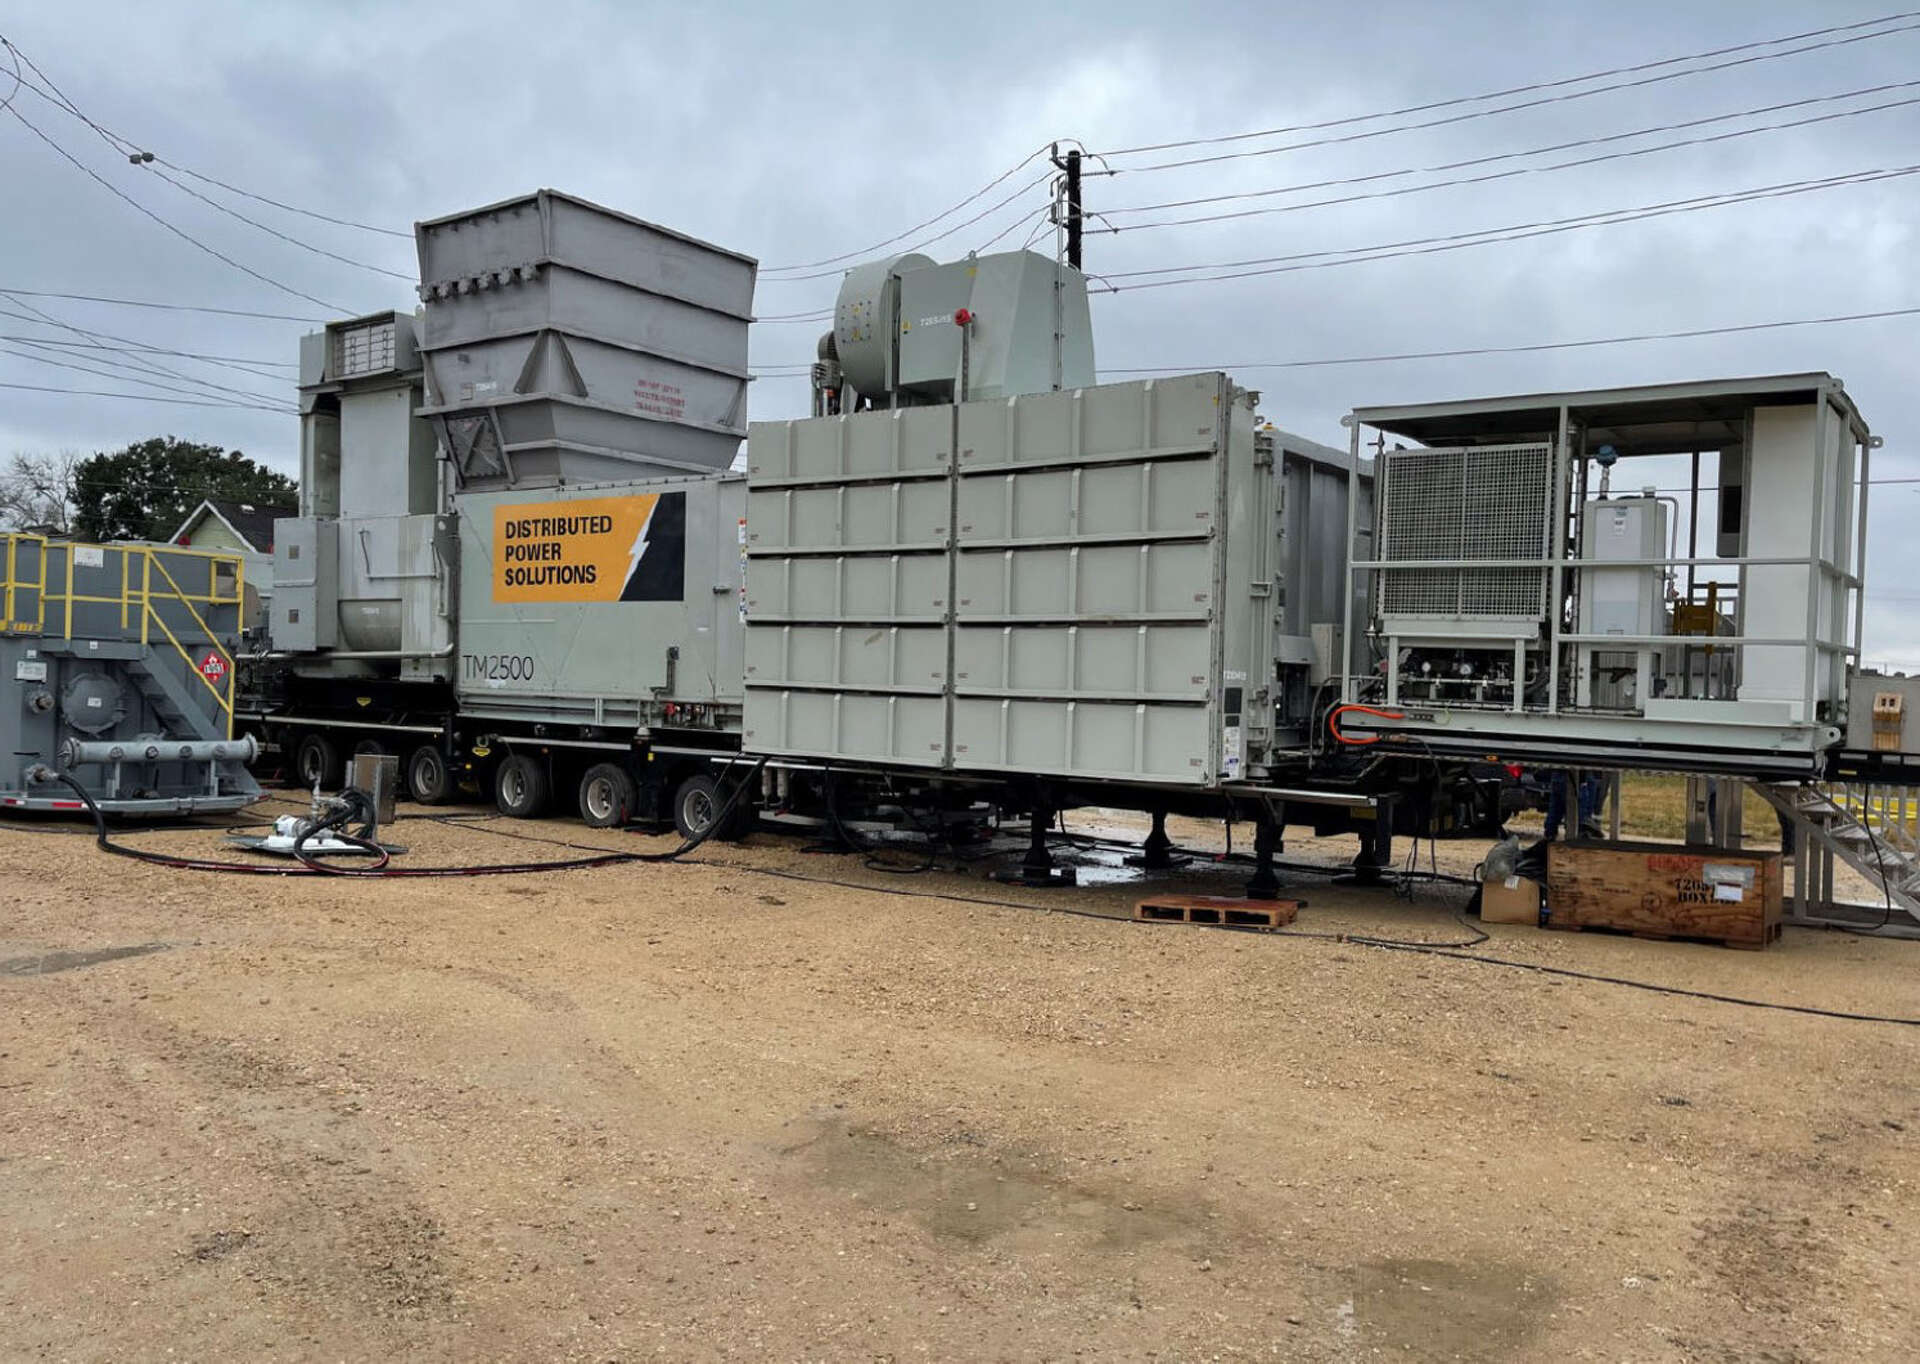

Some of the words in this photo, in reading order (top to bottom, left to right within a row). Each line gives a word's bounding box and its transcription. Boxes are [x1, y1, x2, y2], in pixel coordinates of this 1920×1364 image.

[505, 515, 612, 539] DISTRIBUTED
[505, 542, 562, 562] POWER
[505, 564, 597, 587] SOLUTIONS
[462, 655, 534, 680] TM2500
